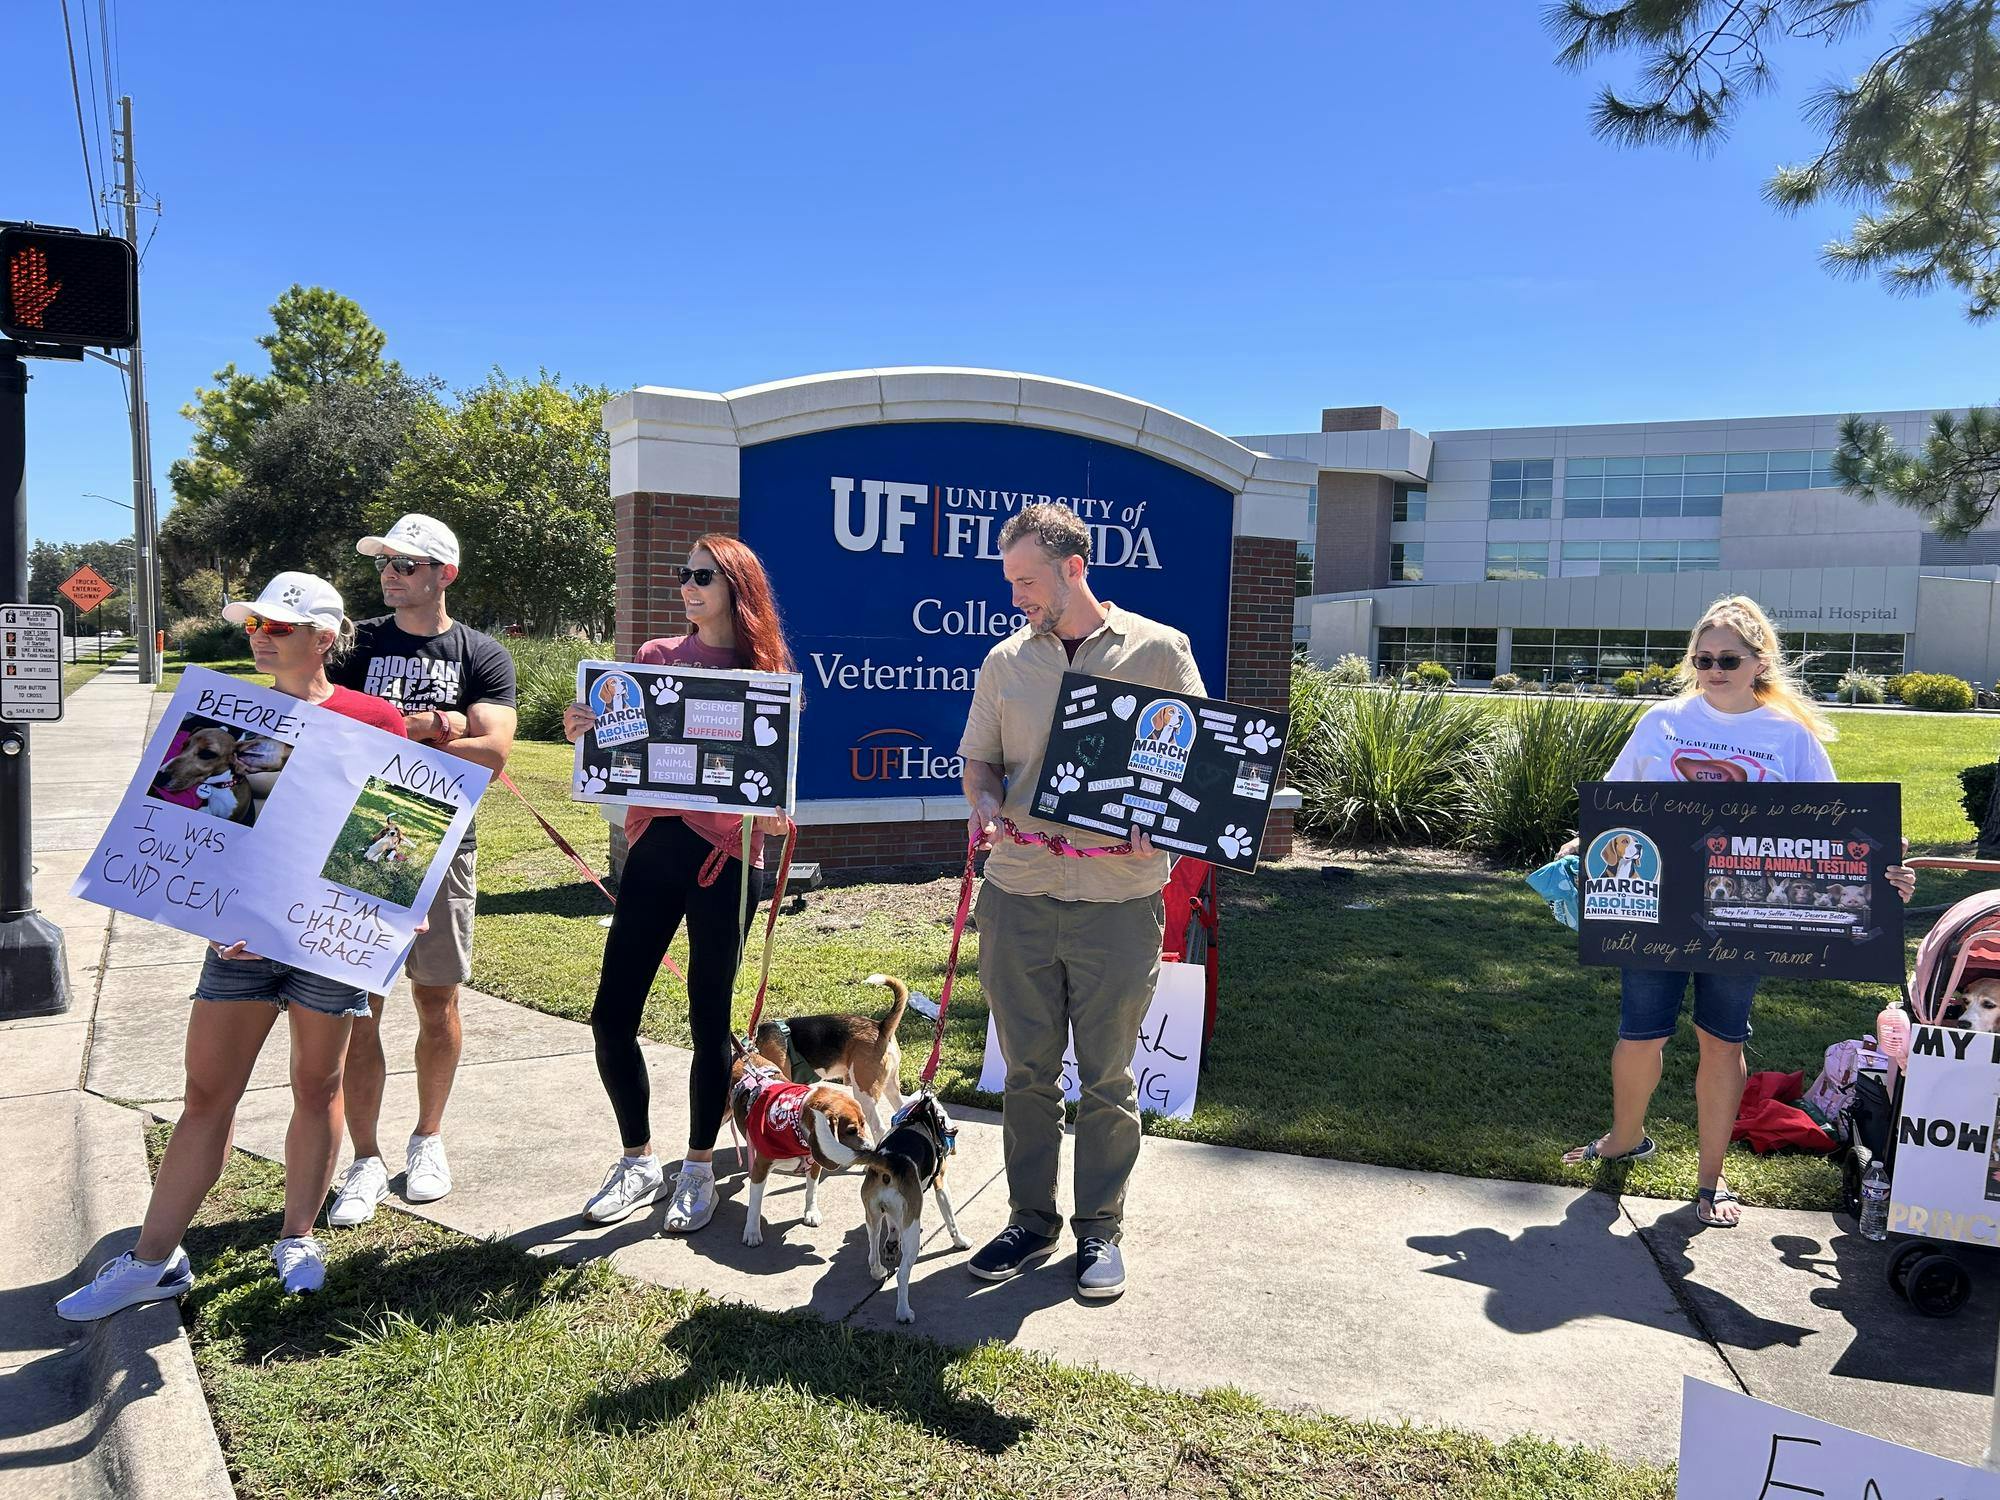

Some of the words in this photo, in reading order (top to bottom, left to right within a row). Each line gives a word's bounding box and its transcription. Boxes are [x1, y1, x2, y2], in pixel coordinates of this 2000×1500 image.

[831, 477, 928, 553] UF
[1121, 501, 1147, 529] of
[912, 599, 1029, 637] Colleg
[1767, 607, 1822, 618] Animal
[1829, 607, 1897, 623] Hospital
[367, 655, 461, 683] RIDGLAN
[810, 654, 981, 691] Veterinar
[364, 676, 459, 705] RELEASE
[197, 690, 305, 738] BEFORE:
[694, 702, 738, 713] SCIENCE
[595, 708, 646, 729] MARCH
[692, 714, 739, 726] WITHOUT
[598, 721, 647, 739] ABOLISH
[598, 735, 622, 745] ANIMAL
[687, 726, 742, 738] SUFFERING
[664, 746, 686, 755] END
[1133, 740, 1188, 763] MARCH
[1686, 740, 1709, 748] GAVE
[1736, 747, 1775, 761] NUMBER.
[655, 759, 692, 769] ANIMAL
[1128, 762, 1153, 771] ANIMAL
[1155, 767, 1182, 779] TESTING
[1131, 753, 1184, 772] ABOLISH
[381, 753, 465, 800] NOW:
[653, 771, 694, 781] TESTING
[1089, 777, 1133, 791] ANIMALS
[1141, 782, 1163, 793] ARE
[1171, 790, 1200, 812] HERE
[1124, 796, 1149, 808] WITH
[1150, 802, 1167, 812] US
[1593, 788, 1658, 816] Until
[1664, 799, 1714, 825] every
[1720, 802, 1757, 822] cage
[1767, 798, 1784, 816] is
[133, 804, 163, 832] I
[184, 821, 226, 853] WAS
[1132, 811, 1155, 824] FOR
[1164, 818, 1179, 830] US
[138, 837, 198, 869] ONLY
[1731, 836, 1830, 859] MARCH
[1831, 843, 1844, 856] TO
[1708, 855, 1761, 870] ABOLISH
[1764, 858, 1814, 872] ANIMAL
[1817, 860, 1868, 875] TESTING
[1586, 878, 1658, 899] MARCH
[322, 889, 383, 931] I'M
[1585, 907, 1618, 915] ANIMAL
[1621, 909, 1658, 918] TESTING
[1586, 896, 1657, 910] ABOLISH
[1789, 911, 1803, 919] They
[298, 931, 374, 968] GRACE
[1683, 938, 1701, 954] #
[1709, 938, 1738, 960] has
[1744, 950, 1756, 960] a
[1913, 1026, 1976, 1060] MY
[1900, 1116, 1989, 1153] NOW
